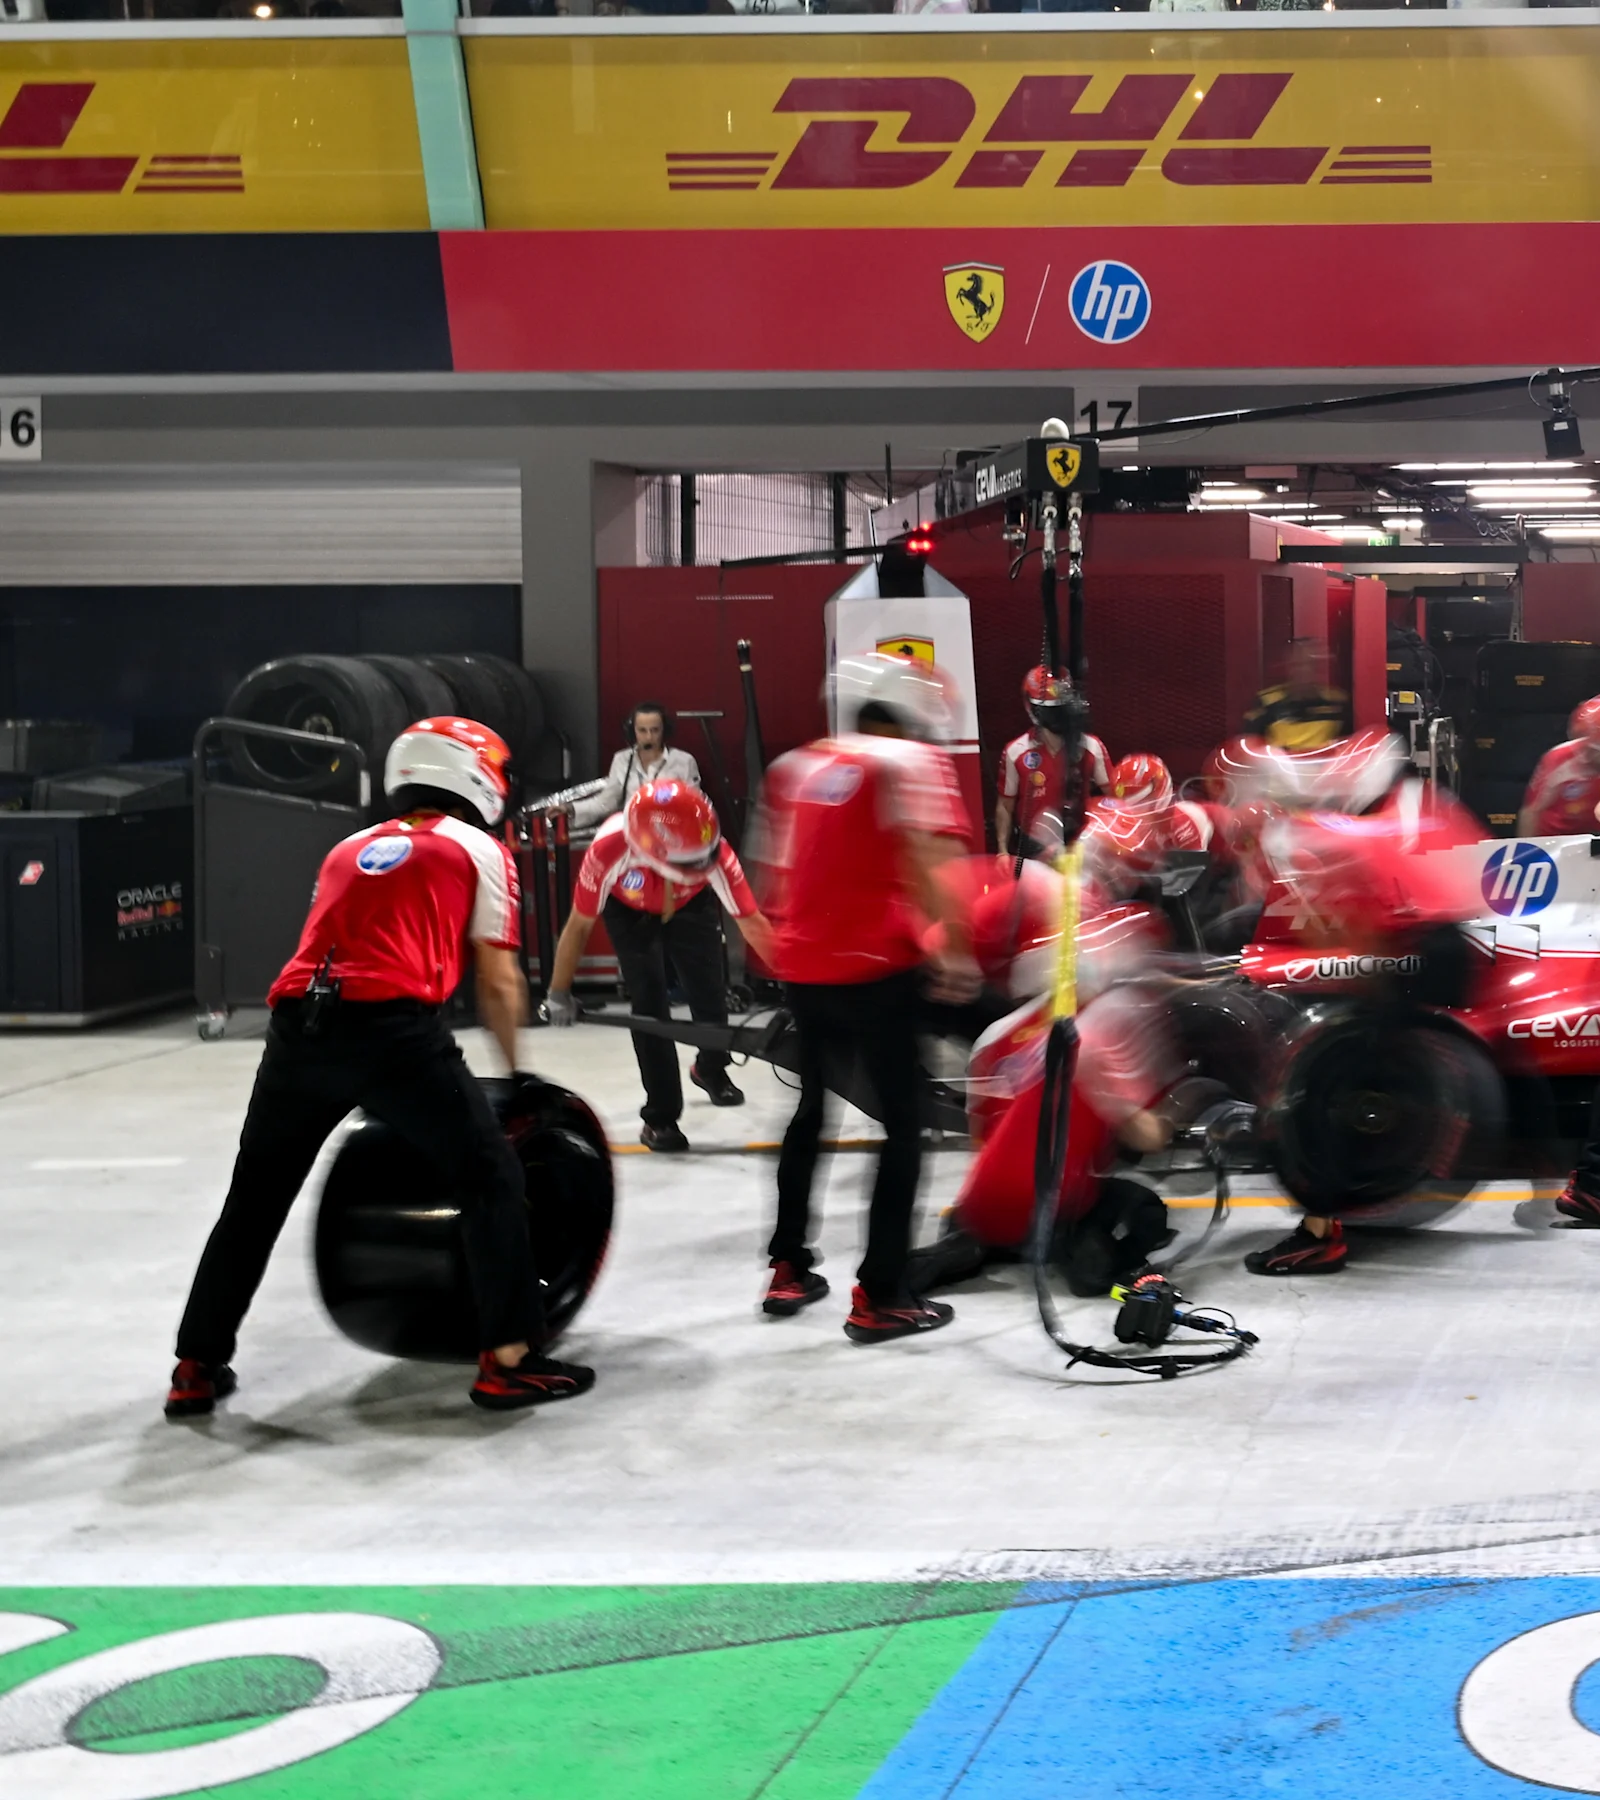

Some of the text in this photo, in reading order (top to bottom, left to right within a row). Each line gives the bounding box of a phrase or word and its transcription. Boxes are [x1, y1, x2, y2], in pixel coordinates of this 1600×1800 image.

[770, 73, 1329, 190] DHL
[1078, 262, 1142, 342] hp
[1080, 400, 1132, 434] 17
[117, 882, 182, 908] ORACLE
[1489, 842, 1552, 918] hp
[117, 920, 184, 941] RACING
